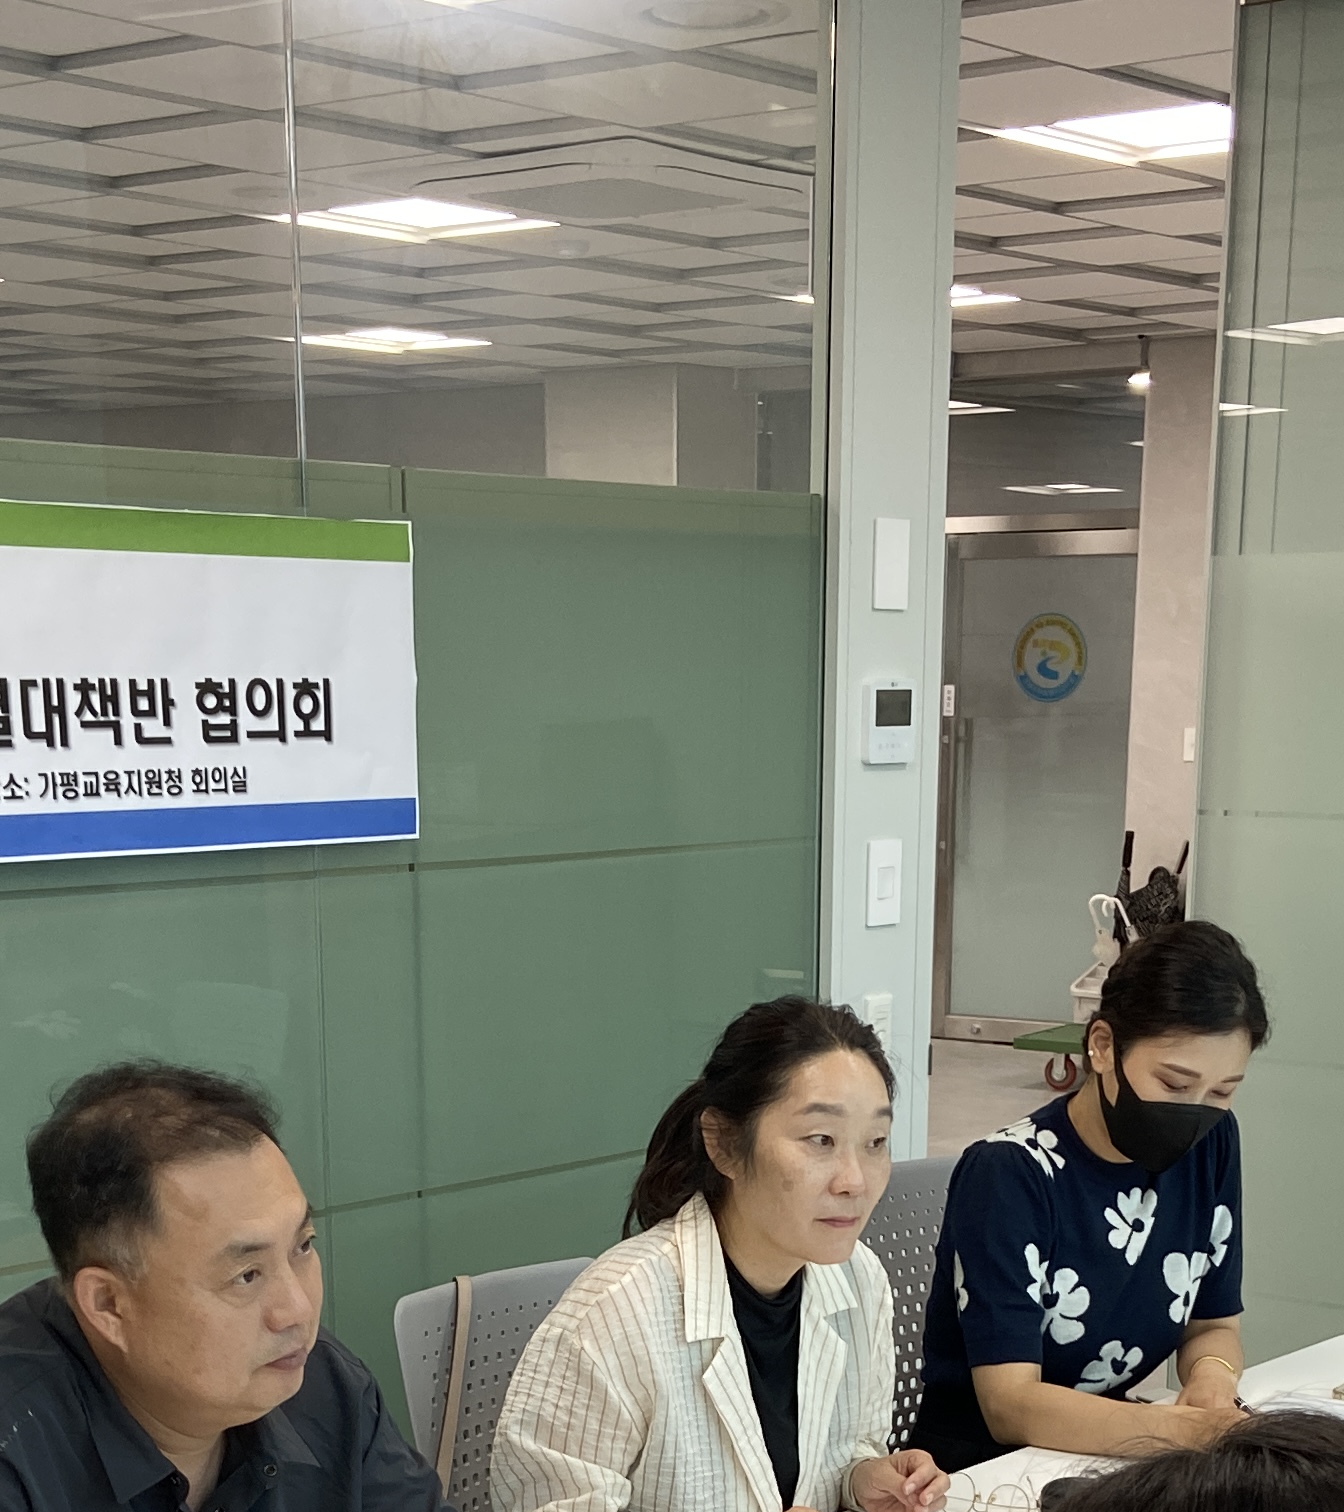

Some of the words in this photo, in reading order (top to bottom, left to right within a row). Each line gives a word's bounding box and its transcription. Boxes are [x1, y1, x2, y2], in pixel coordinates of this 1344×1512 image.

[194, 676, 333, 745] 협의회
[38, 768, 183, 800] 가평교육지원청
[191, 765, 248, 795] 회의실
